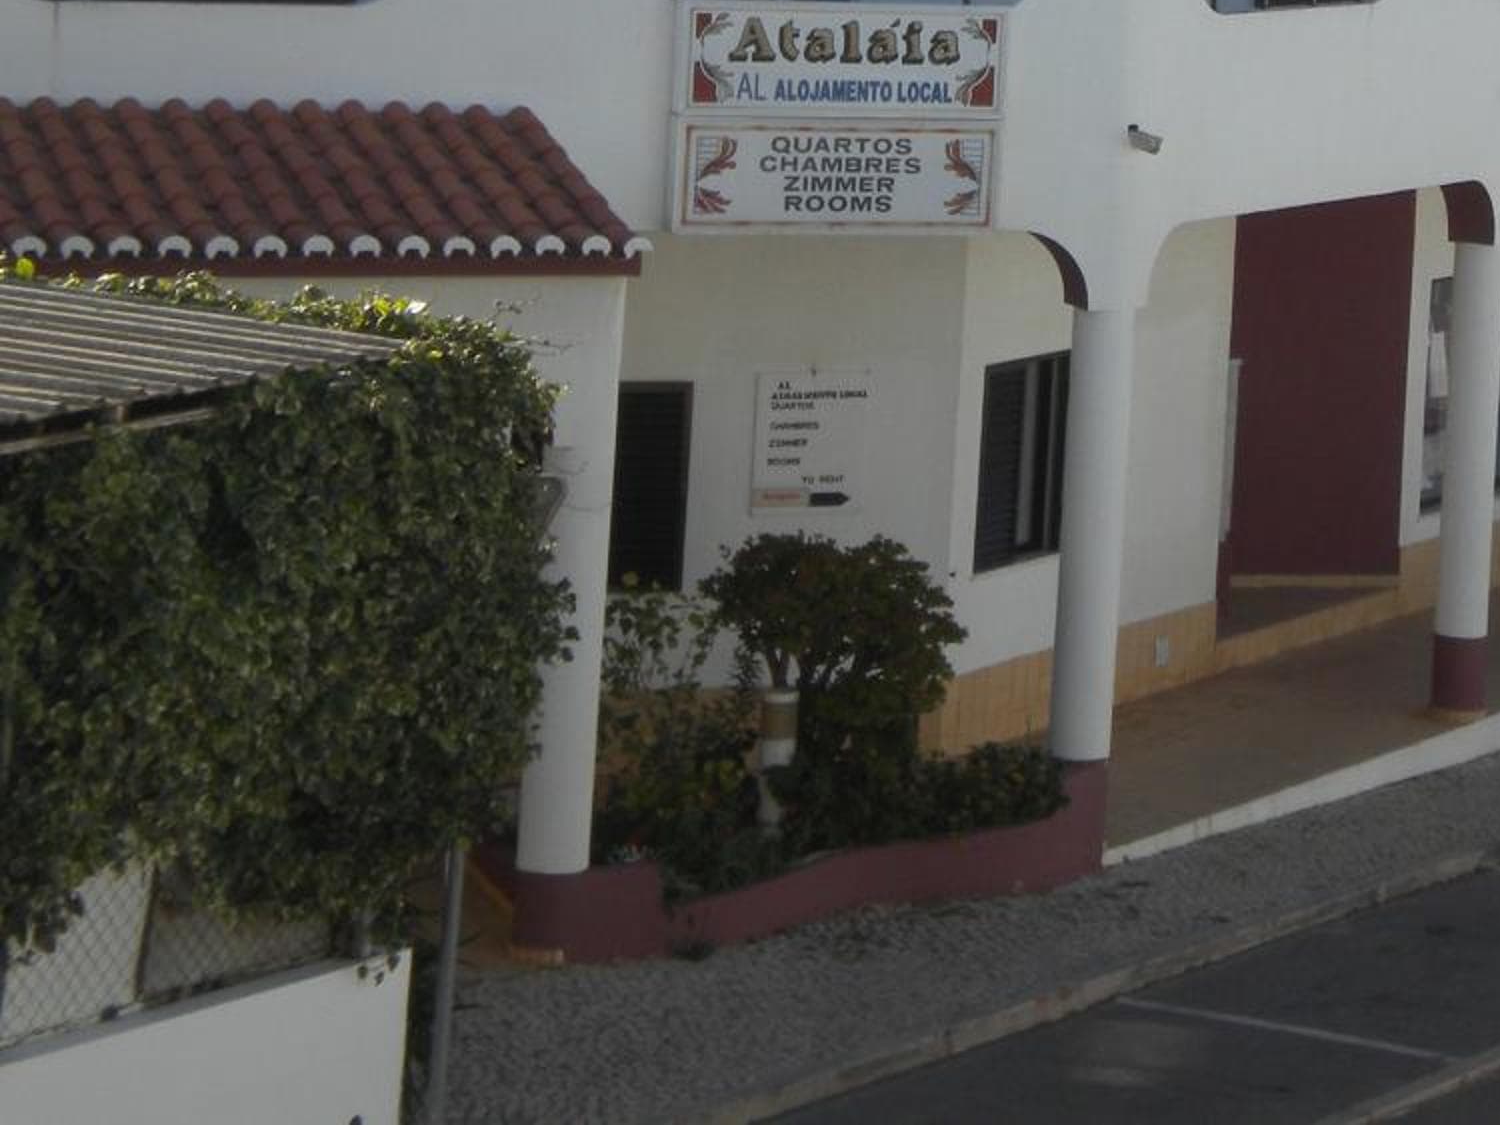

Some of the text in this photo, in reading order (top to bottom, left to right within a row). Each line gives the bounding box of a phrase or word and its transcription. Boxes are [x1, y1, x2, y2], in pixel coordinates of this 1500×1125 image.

[736, 72, 953, 104] AL ALOJAMENTO LOCAL
[771, 136, 912, 155] QUARTOS
[760, 155, 922, 174] CHAMBRES
[783, 176, 895, 193] ZIMMER
[784, 195, 892, 213] ROOMS
